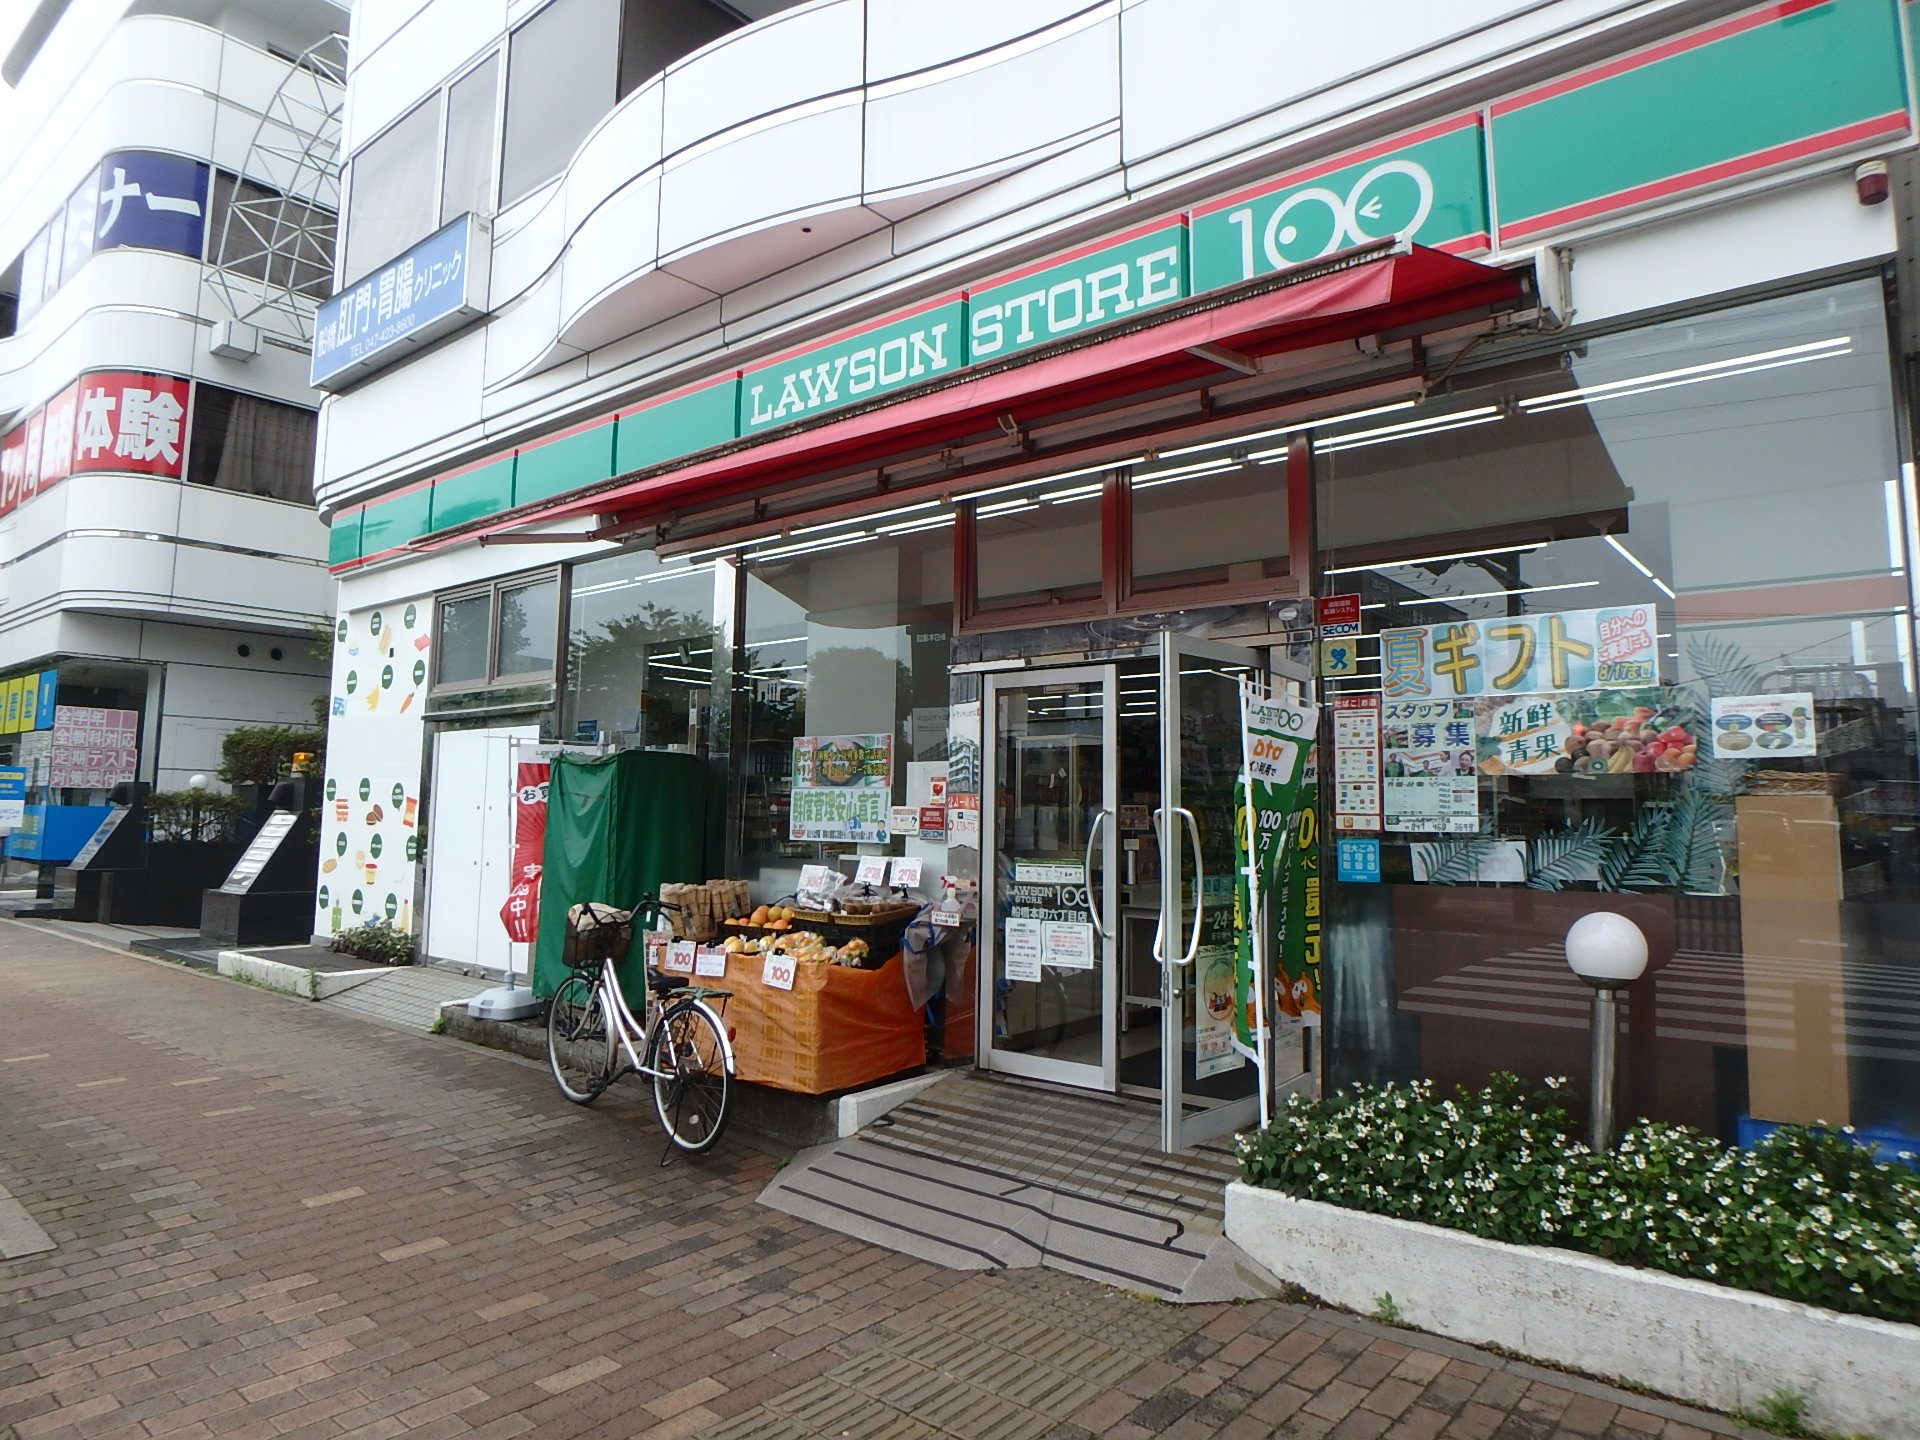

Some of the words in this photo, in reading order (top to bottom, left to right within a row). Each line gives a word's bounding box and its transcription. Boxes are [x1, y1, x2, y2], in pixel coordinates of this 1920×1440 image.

[749, 321, 948, 426] LAWSON
[971, 245, 1179, 357] STORE
[1228, 159, 1434, 282] 100
[1323, 622, 1359, 637] SECOM
[1599, 608, 1648, 641] 自分への
[1381, 614, 1595, 698] 夏ギフト
[58, 707, 105, 727] 全学年
[1386, 702, 1450, 721] スタッフ
[1499, 702, 1552, 735] 新鮮
[55, 728, 135, 749] 全教科対応
[1412, 722, 1470, 748] 募集
[53, 748, 137, 766] 定期テスト
[1506, 733, 1561, 765] 青果
[793, 790, 889, 823] 鮮度管理安心宣言!
[865, 866, 881, 880] 278
[899, 869, 918, 882] 278
[1006, 885, 1053, 898] LAWSON
[1015, 895, 1043, 904] STORE
[1011, 905, 1088, 923] 船橋本町六丁目店
[674, 951, 692, 966] 100
[771, 965, 791, 983] 100
